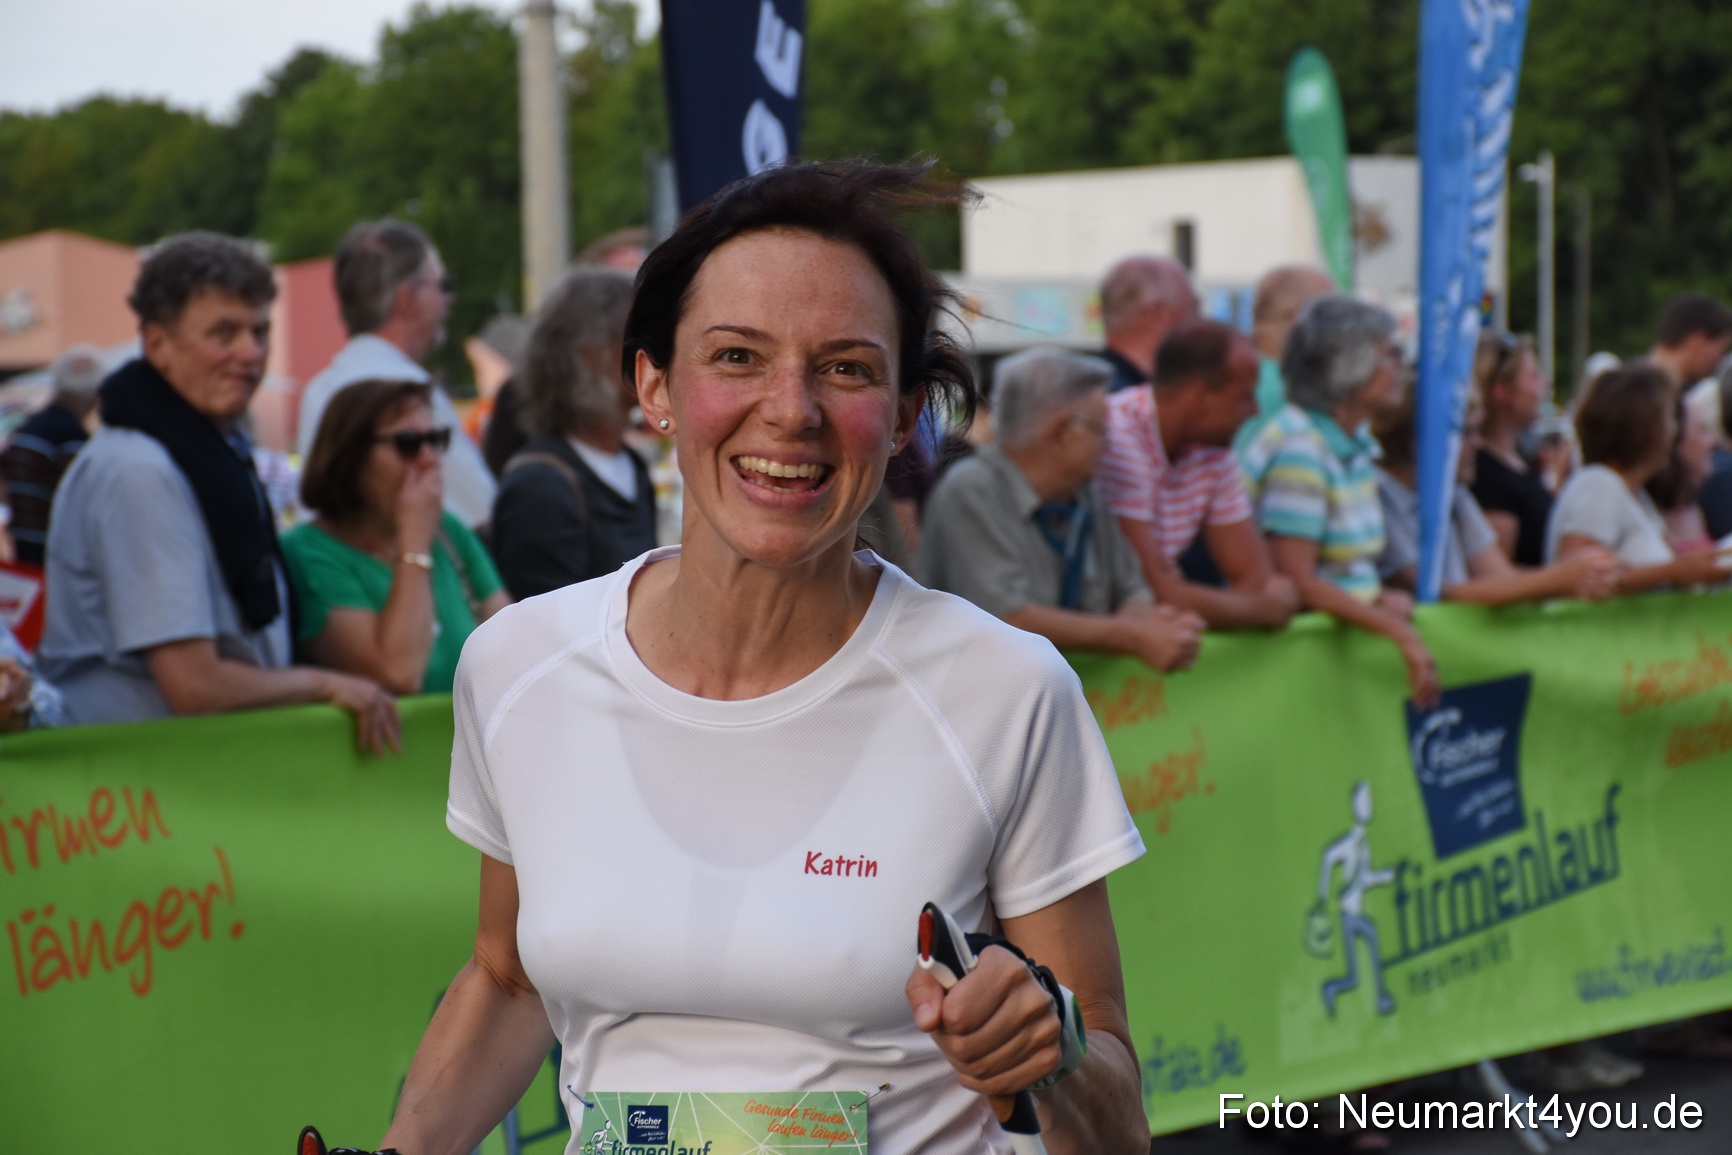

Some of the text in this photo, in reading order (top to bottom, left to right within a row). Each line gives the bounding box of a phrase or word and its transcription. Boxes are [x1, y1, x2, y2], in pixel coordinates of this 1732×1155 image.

[804, 851, 878, 877] Katrin
[1393, 782, 1622, 957] firmenlauf
[7, 845, 245, 997] länger!
[634, 1116, 662, 1125] Fischer
[744, 1099, 845, 1125] Gesunde Firmen
[767, 1119, 858, 1147] laufen länger!
